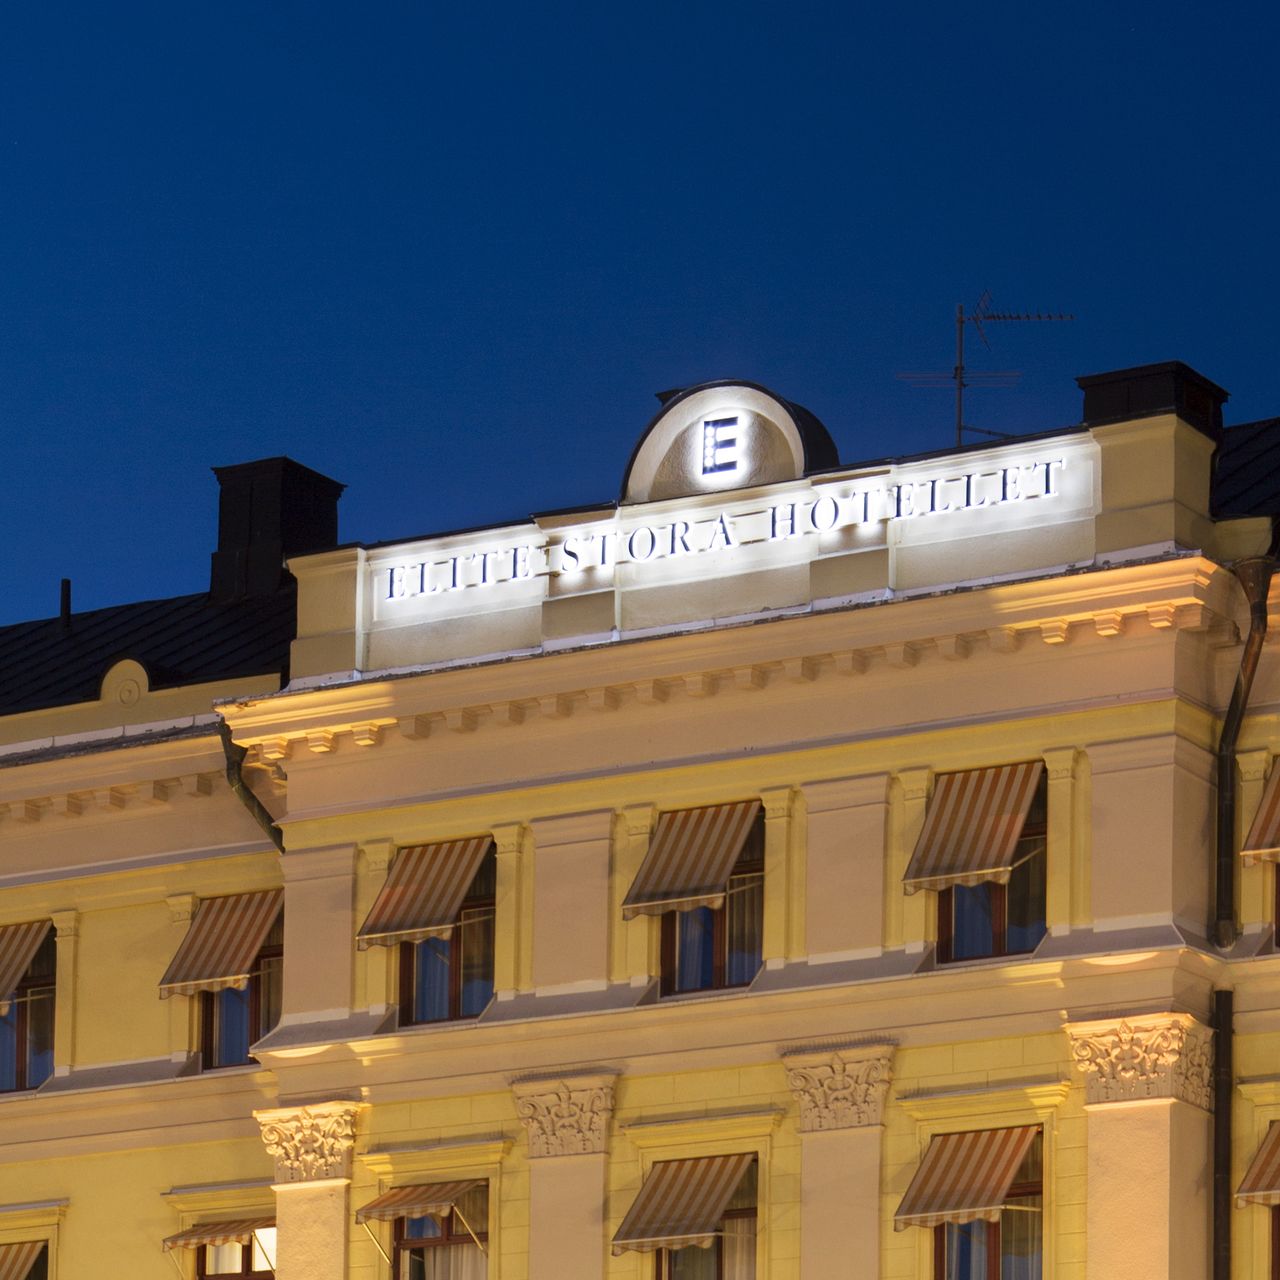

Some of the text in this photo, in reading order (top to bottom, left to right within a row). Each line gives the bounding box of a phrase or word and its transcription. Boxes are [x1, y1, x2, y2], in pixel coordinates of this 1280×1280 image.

[702, 415, 739, 476] E
[386, 457, 1066, 600] ELITE STORA HOTELLET
